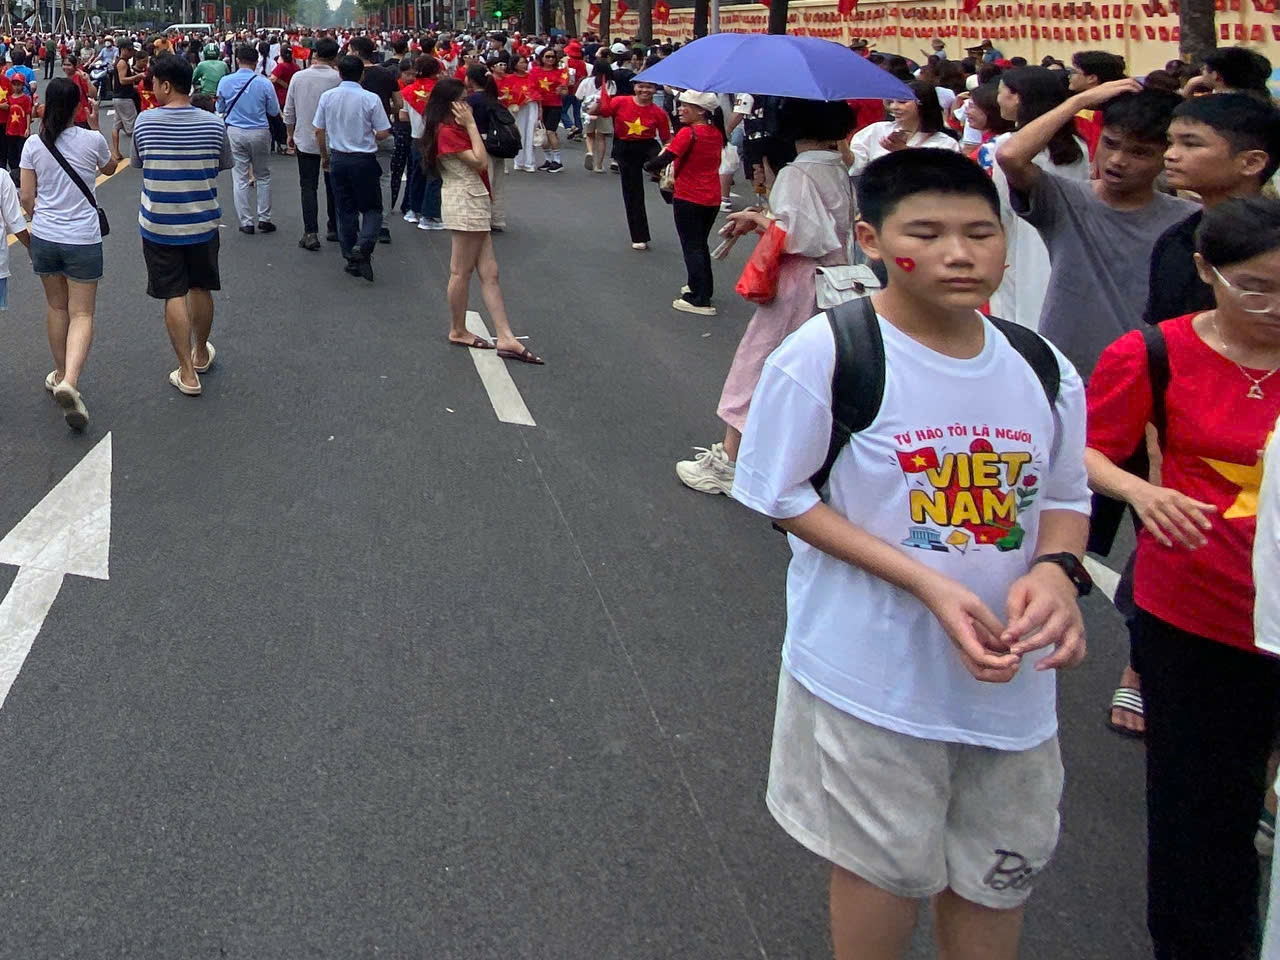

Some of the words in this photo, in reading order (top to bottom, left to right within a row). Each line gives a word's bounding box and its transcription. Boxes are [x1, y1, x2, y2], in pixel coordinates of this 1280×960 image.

[893, 431, 912, 447] TỰ
[915, 425, 944, 441] HÀO
[947, 422, 967, 437] TÔI
[972, 424, 990, 437] LÀ
[909, 488, 1017, 528] NAM
